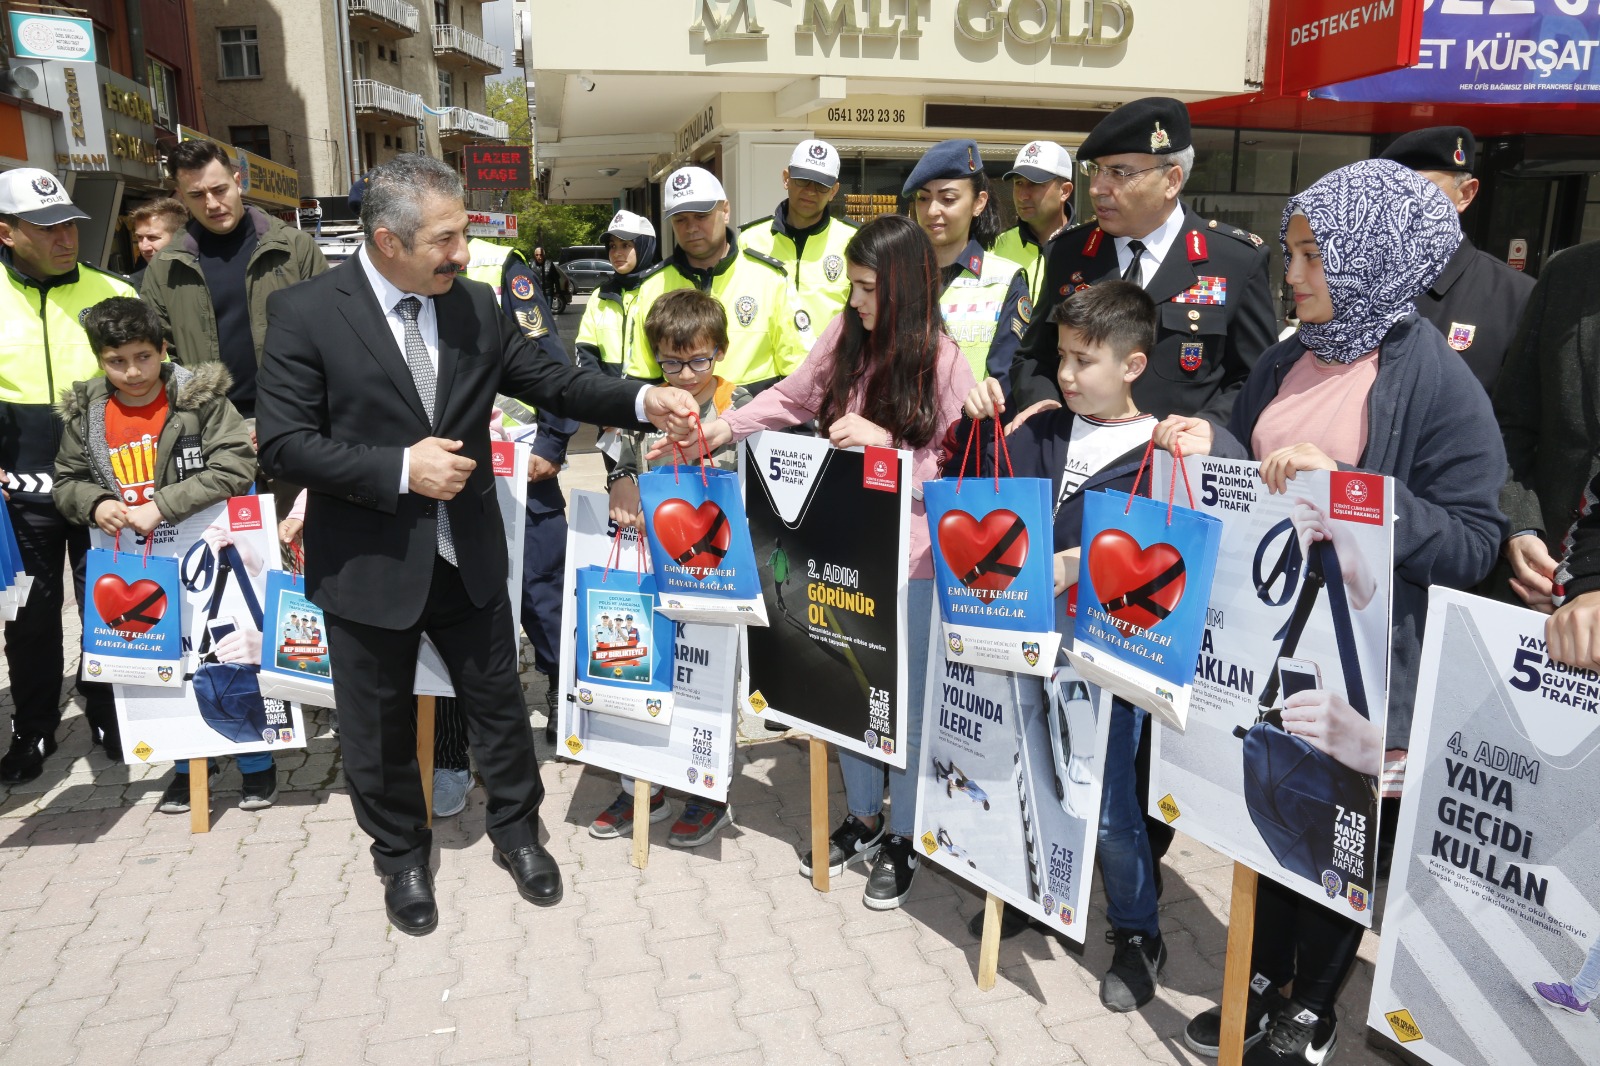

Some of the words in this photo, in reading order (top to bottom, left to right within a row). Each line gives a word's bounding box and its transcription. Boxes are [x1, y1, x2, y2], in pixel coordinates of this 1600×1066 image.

[957, 0, 1135, 45] GOLD
[1465, 32, 1600, 78] KÜRŞAT
[1523, 82, 1536, 90] BİR
[1537, 82, 1573, 91] FRANCHISE
[828, 107, 853, 122] 0541
[856, 108, 874, 123] 323
[877, 109, 890, 123] 23
[892, 109, 905, 123] 36
[473, 152, 521, 164] LAZER
[478, 168, 518, 182] KAŞE
[949, 324, 996, 343] RAFİK
[770, 448, 798, 459] YAYALAR
[799, 453, 813, 461] İÇİN
[769, 456, 781, 481] 5
[781, 459, 807, 469] ADIMDA
[781, 467, 809, 478] GÜVENLİ
[1202, 461, 1241, 476] YAYALAR
[781, 475, 804, 486] TRAFİK
[1219, 475, 1254, 490] ADIMDA
[1201, 473, 1219, 507] 5
[1219, 488, 1257, 503] GÜVENLİ
[1219, 499, 1250, 513] TRAFİK
[620, 532, 639, 543] TRAFİ
[664, 564, 702, 576] EMNİYET
[702, 566, 737, 578] KEMERİ
[807, 558, 820, 579] 2.
[823, 562, 859, 589] ADIM
[668, 578, 698, 589] HAYATA
[699, 580, 737, 592] BAĞLAR.
[947, 585, 988, 599] EMNİYET
[989, 588, 1029, 601] KEMERİ
[807, 582, 875, 617] GÖRÜNÜR
[808, 603, 828, 628] OL
[952, 602, 985, 615] HAYATA
[986, 605, 1027, 619] BAĞLAR.
[93, 627, 132, 638] EMNİYET
[131, 630, 165, 641] KEMERİ
[1087, 606, 1130, 631] EMNİYET
[1129, 624, 1173, 647] KEMERİ
[95, 639, 128, 649] HAYATA
[127, 640, 164, 652] BAĞLAR.
[1088, 624, 1121, 647] HAYATA
[1123, 639, 1165, 665] BAĞLAR.
[1518, 633, 1549, 654] YAY
[595, 650, 608, 660] HEP
[944, 657, 975, 687] YAYA
[1195, 653, 1254, 696] AKLAN
[1508, 648, 1543, 693] 5
[1544, 657, 1600, 684] ADIMD
[869, 686, 890, 703] 7-13
[1541, 672, 1600, 701] GÜVEN
[869, 698, 890, 712] MAYIS
[942, 682, 1003, 725] YOLUNDA
[1541, 685, 1599, 715] TRAFİK
[264, 705, 285, 714] 2022
[265, 712, 287, 721] TRAFİK
[869, 706, 889, 720] 2022
[869, 715, 890, 728] TRAFİK
[939, 704, 983, 743] İLERLE
[692, 726, 713, 741] 7-13
[692, 737, 713, 749] MAYIS
[692, 744, 712, 757] 2022
[1446, 731, 1468, 758] 4.
[1473, 740, 1541, 785] ADIM
[1444, 757, 1513, 813] YAYA
[1335, 804, 1366, 832] 7-13
[1334, 821, 1366, 844] MAYIS
[1437, 796, 1534, 860] GEÇİDİ
[1051, 842, 1074, 864] 7-13
[1333, 832, 1365, 858] 2022
[1050, 856, 1073, 874] MAYIS
[1333, 846, 1365, 870] TRAFİK
[1049, 864, 1071, 884] 2022
[1431, 829, 1549, 907] KULLAN
[1049, 876, 1071, 893] TRAFİK
[1470, 888, 1481, 898] ve
[1495, 890, 1515, 905] yaya
[1516, 901, 1527, 910] ve
[1528, 905, 1547, 920] okul
